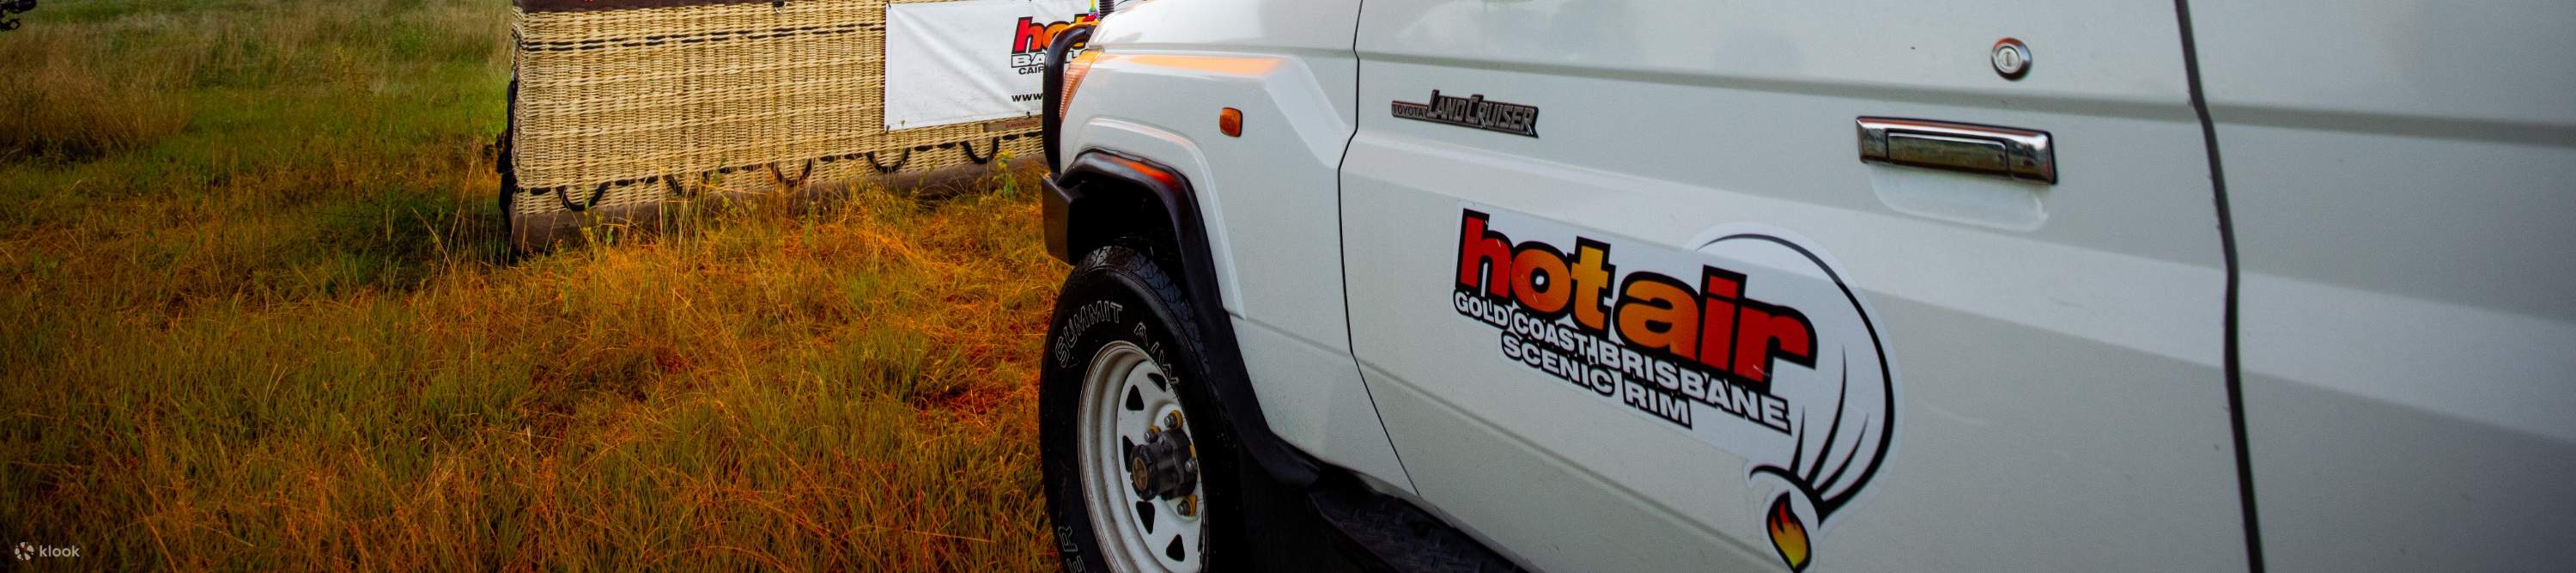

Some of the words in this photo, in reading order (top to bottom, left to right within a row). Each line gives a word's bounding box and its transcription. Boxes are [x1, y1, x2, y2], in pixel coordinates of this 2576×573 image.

[1393, 104, 1425, 118] TOYOTA
[1055, 300, 1124, 369] SUMMIT
[1455, 209, 1616, 332] hot
[1613, 265, 1818, 394] air
[1454, 290, 1510, 328] GOLD
[1513, 311, 1589, 357] COAST
[1598, 339, 1790, 434] BRISBANE
[1502, 334, 1614, 395] SCENIC
[1624, 379, 1692, 429] RIM
